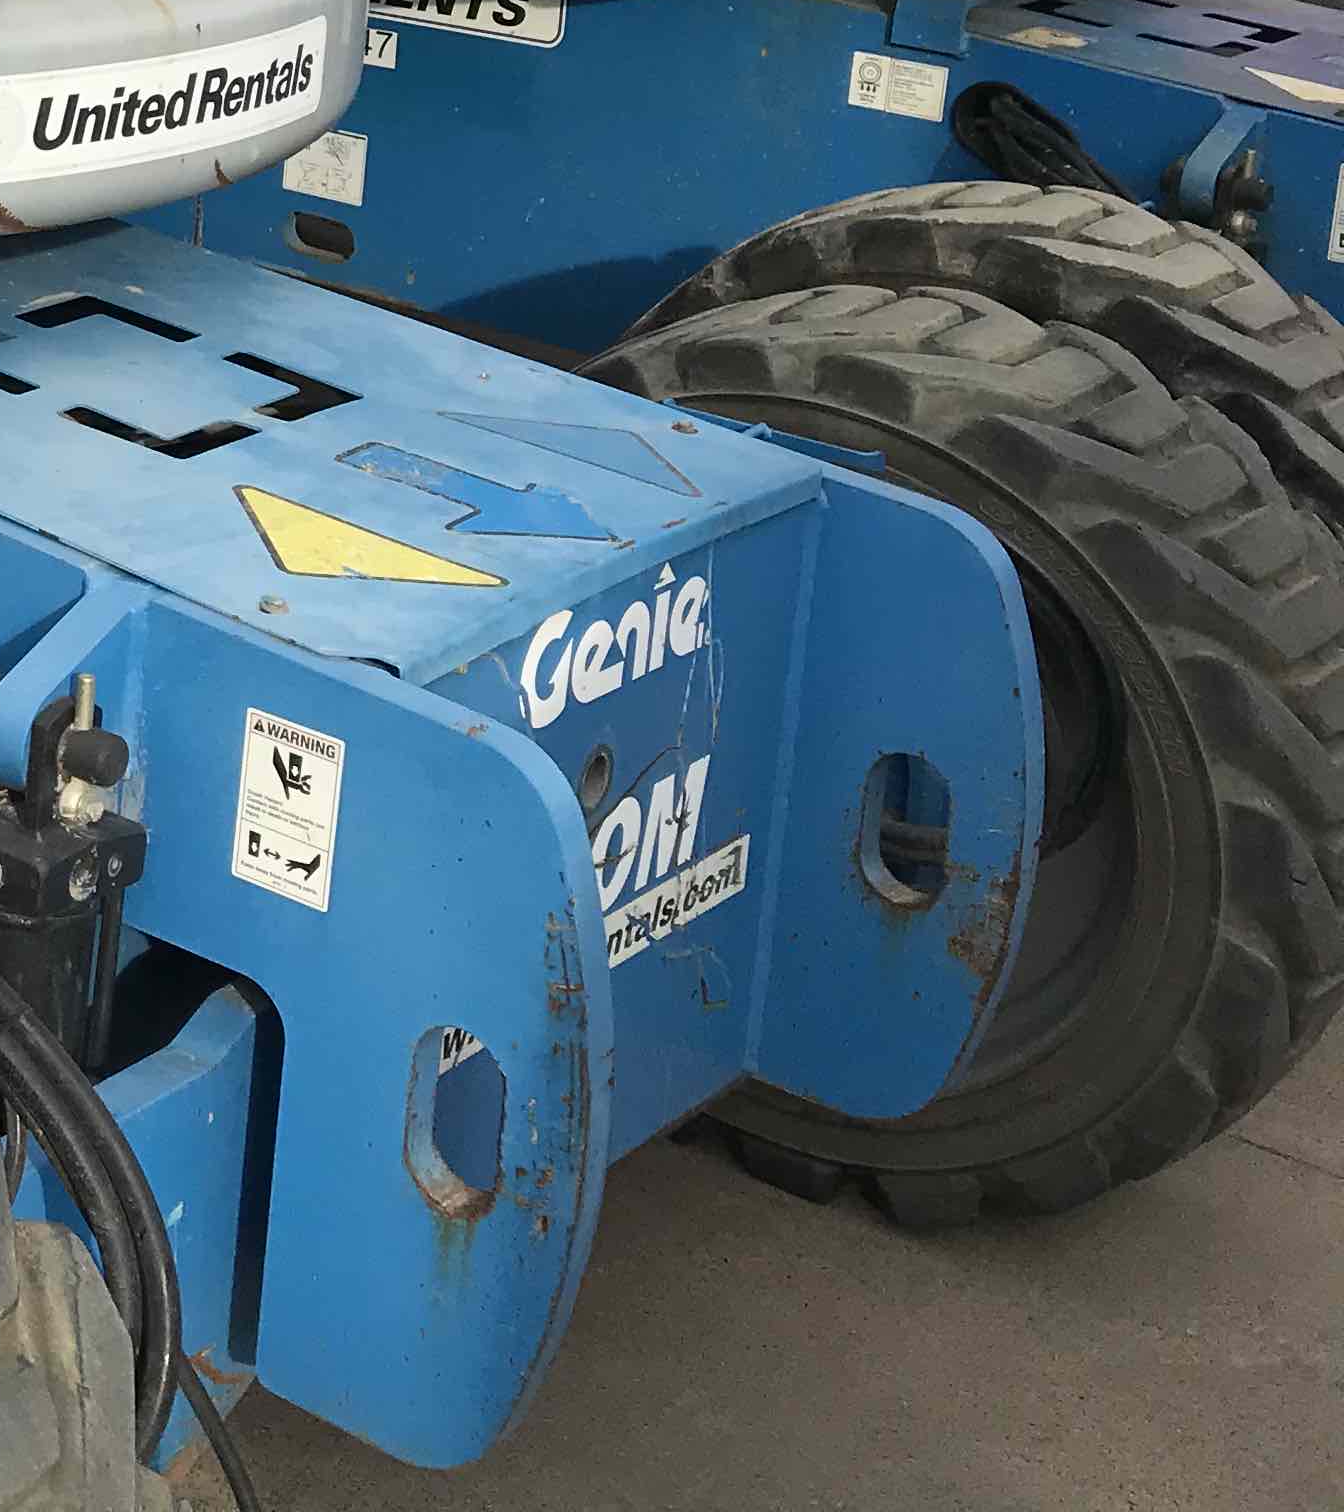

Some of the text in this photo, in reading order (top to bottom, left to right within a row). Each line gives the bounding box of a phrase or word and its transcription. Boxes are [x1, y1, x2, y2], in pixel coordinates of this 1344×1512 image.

[33, 44, 313, 151] United Rentals
[267, 721, 336, 759] WARNING
